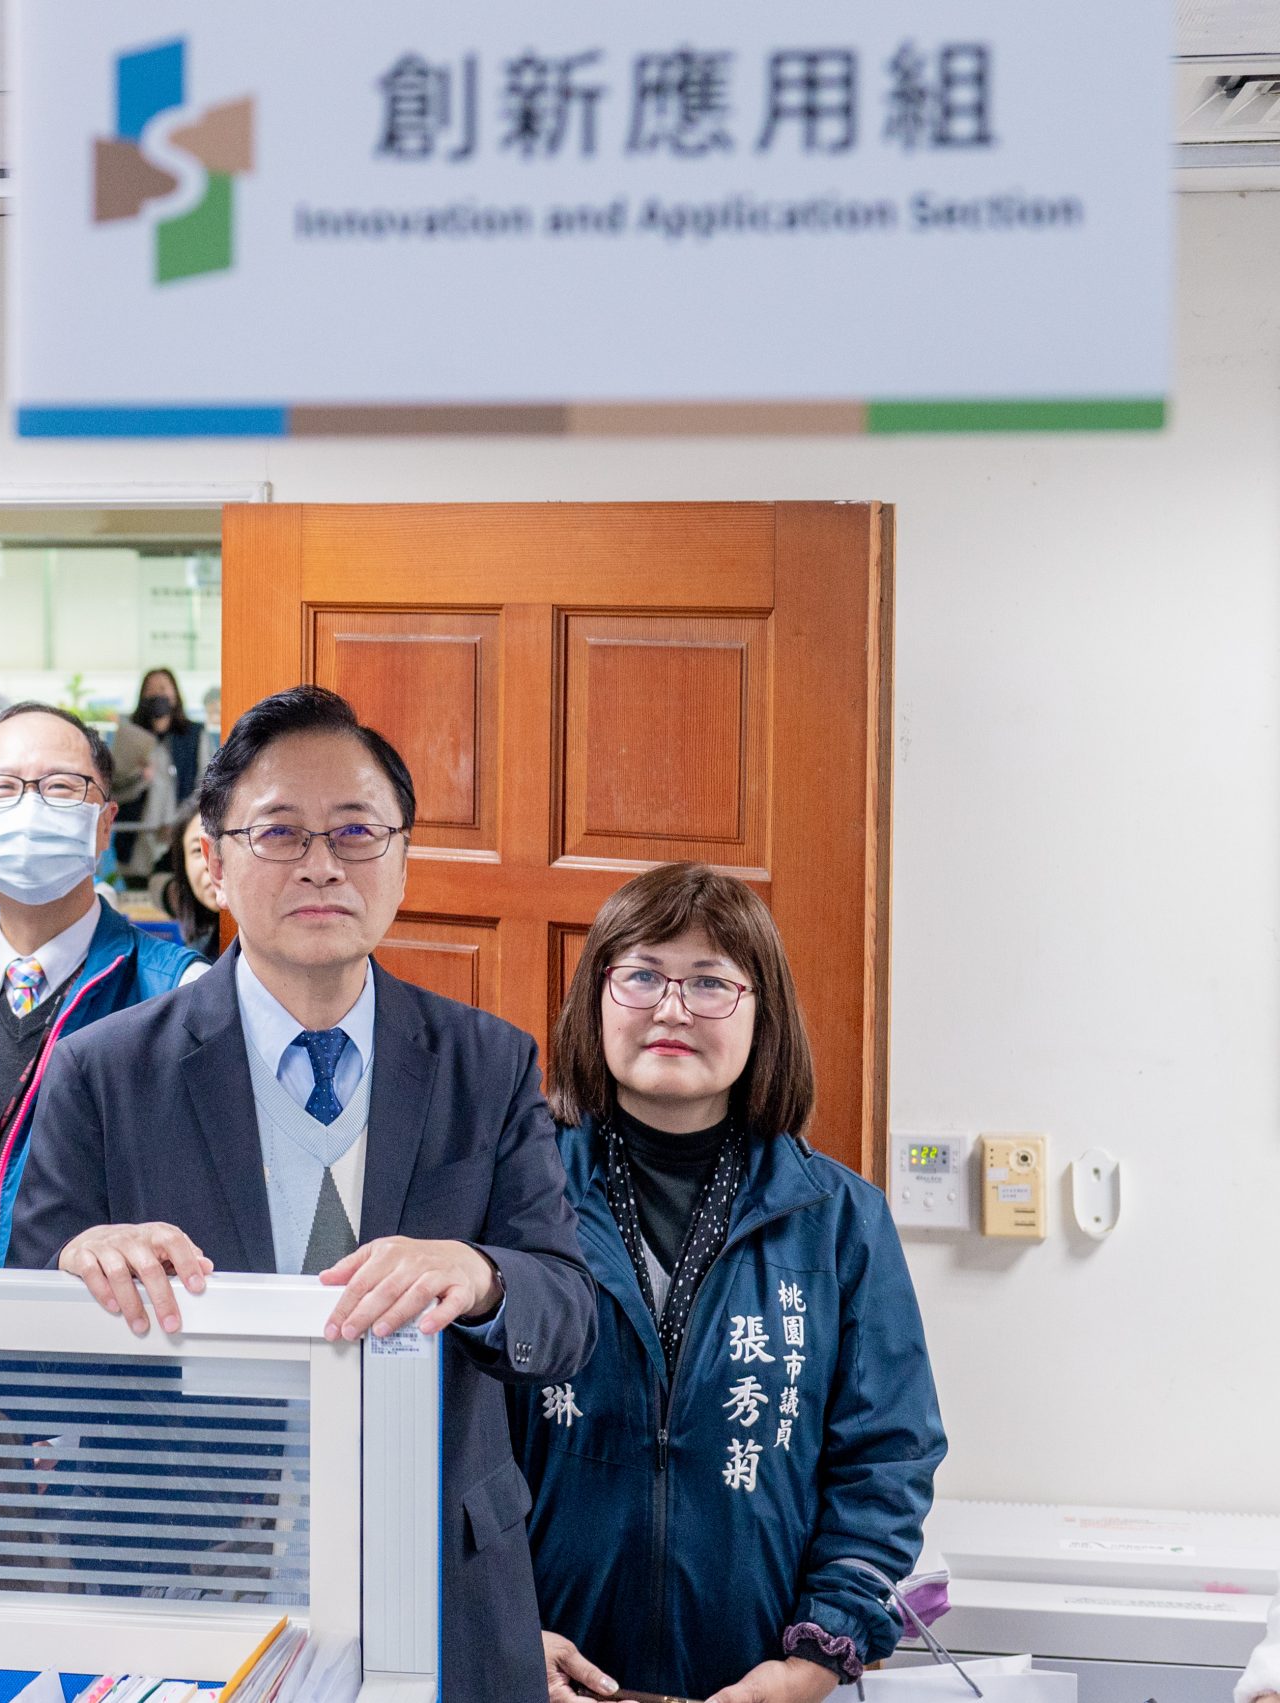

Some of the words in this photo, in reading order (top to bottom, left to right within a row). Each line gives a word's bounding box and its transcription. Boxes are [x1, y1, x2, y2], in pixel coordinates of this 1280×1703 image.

[373, 44, 997, 160] 創新應用組
[296, 203, 528, 239] Innovation
[544, 202, 625, 236] and
[636, 197, 898, 240] Application
[911, 194, 1084, 231] Section
[920, 1146, 938, 1159] 22
[540, 1381, 584, 1428] 琳
[721, 1314, 776, 1493] 張秀菊
[773, 1280, 806, 1451] 桃園市議員
